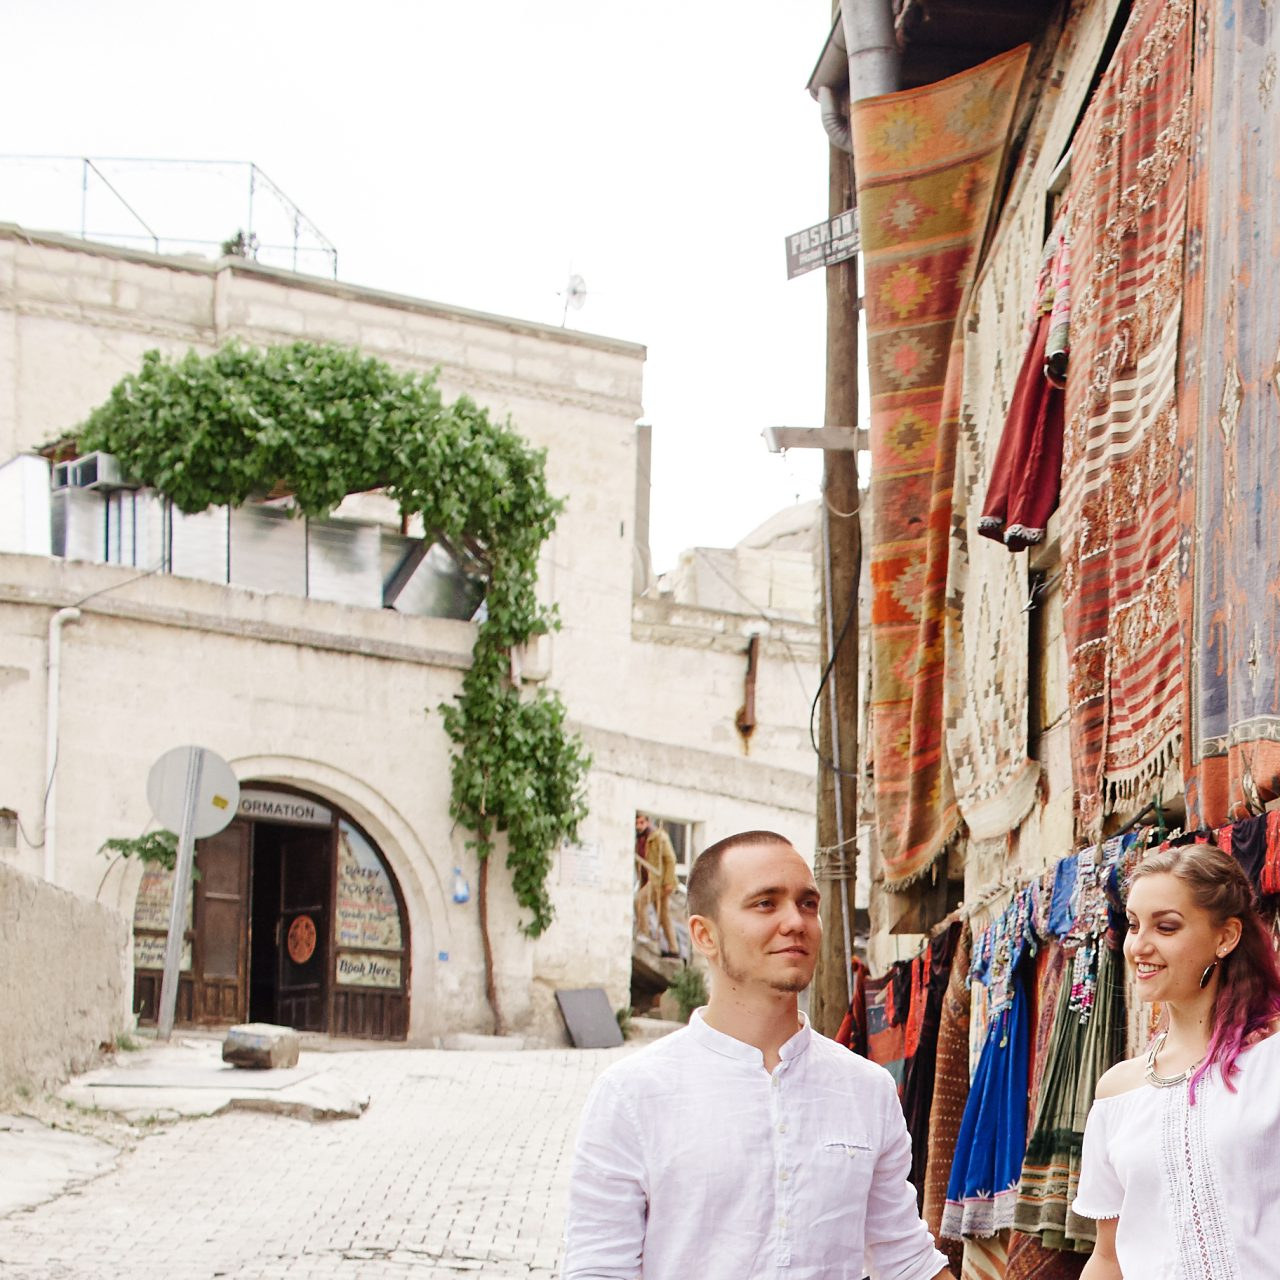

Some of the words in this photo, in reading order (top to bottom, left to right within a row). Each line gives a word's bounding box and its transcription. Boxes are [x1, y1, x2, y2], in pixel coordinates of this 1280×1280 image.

[241, 799, 315, 818] ORMATION
[339, 959, 366, 977] Book
[368, 961, 392, 977] Here
